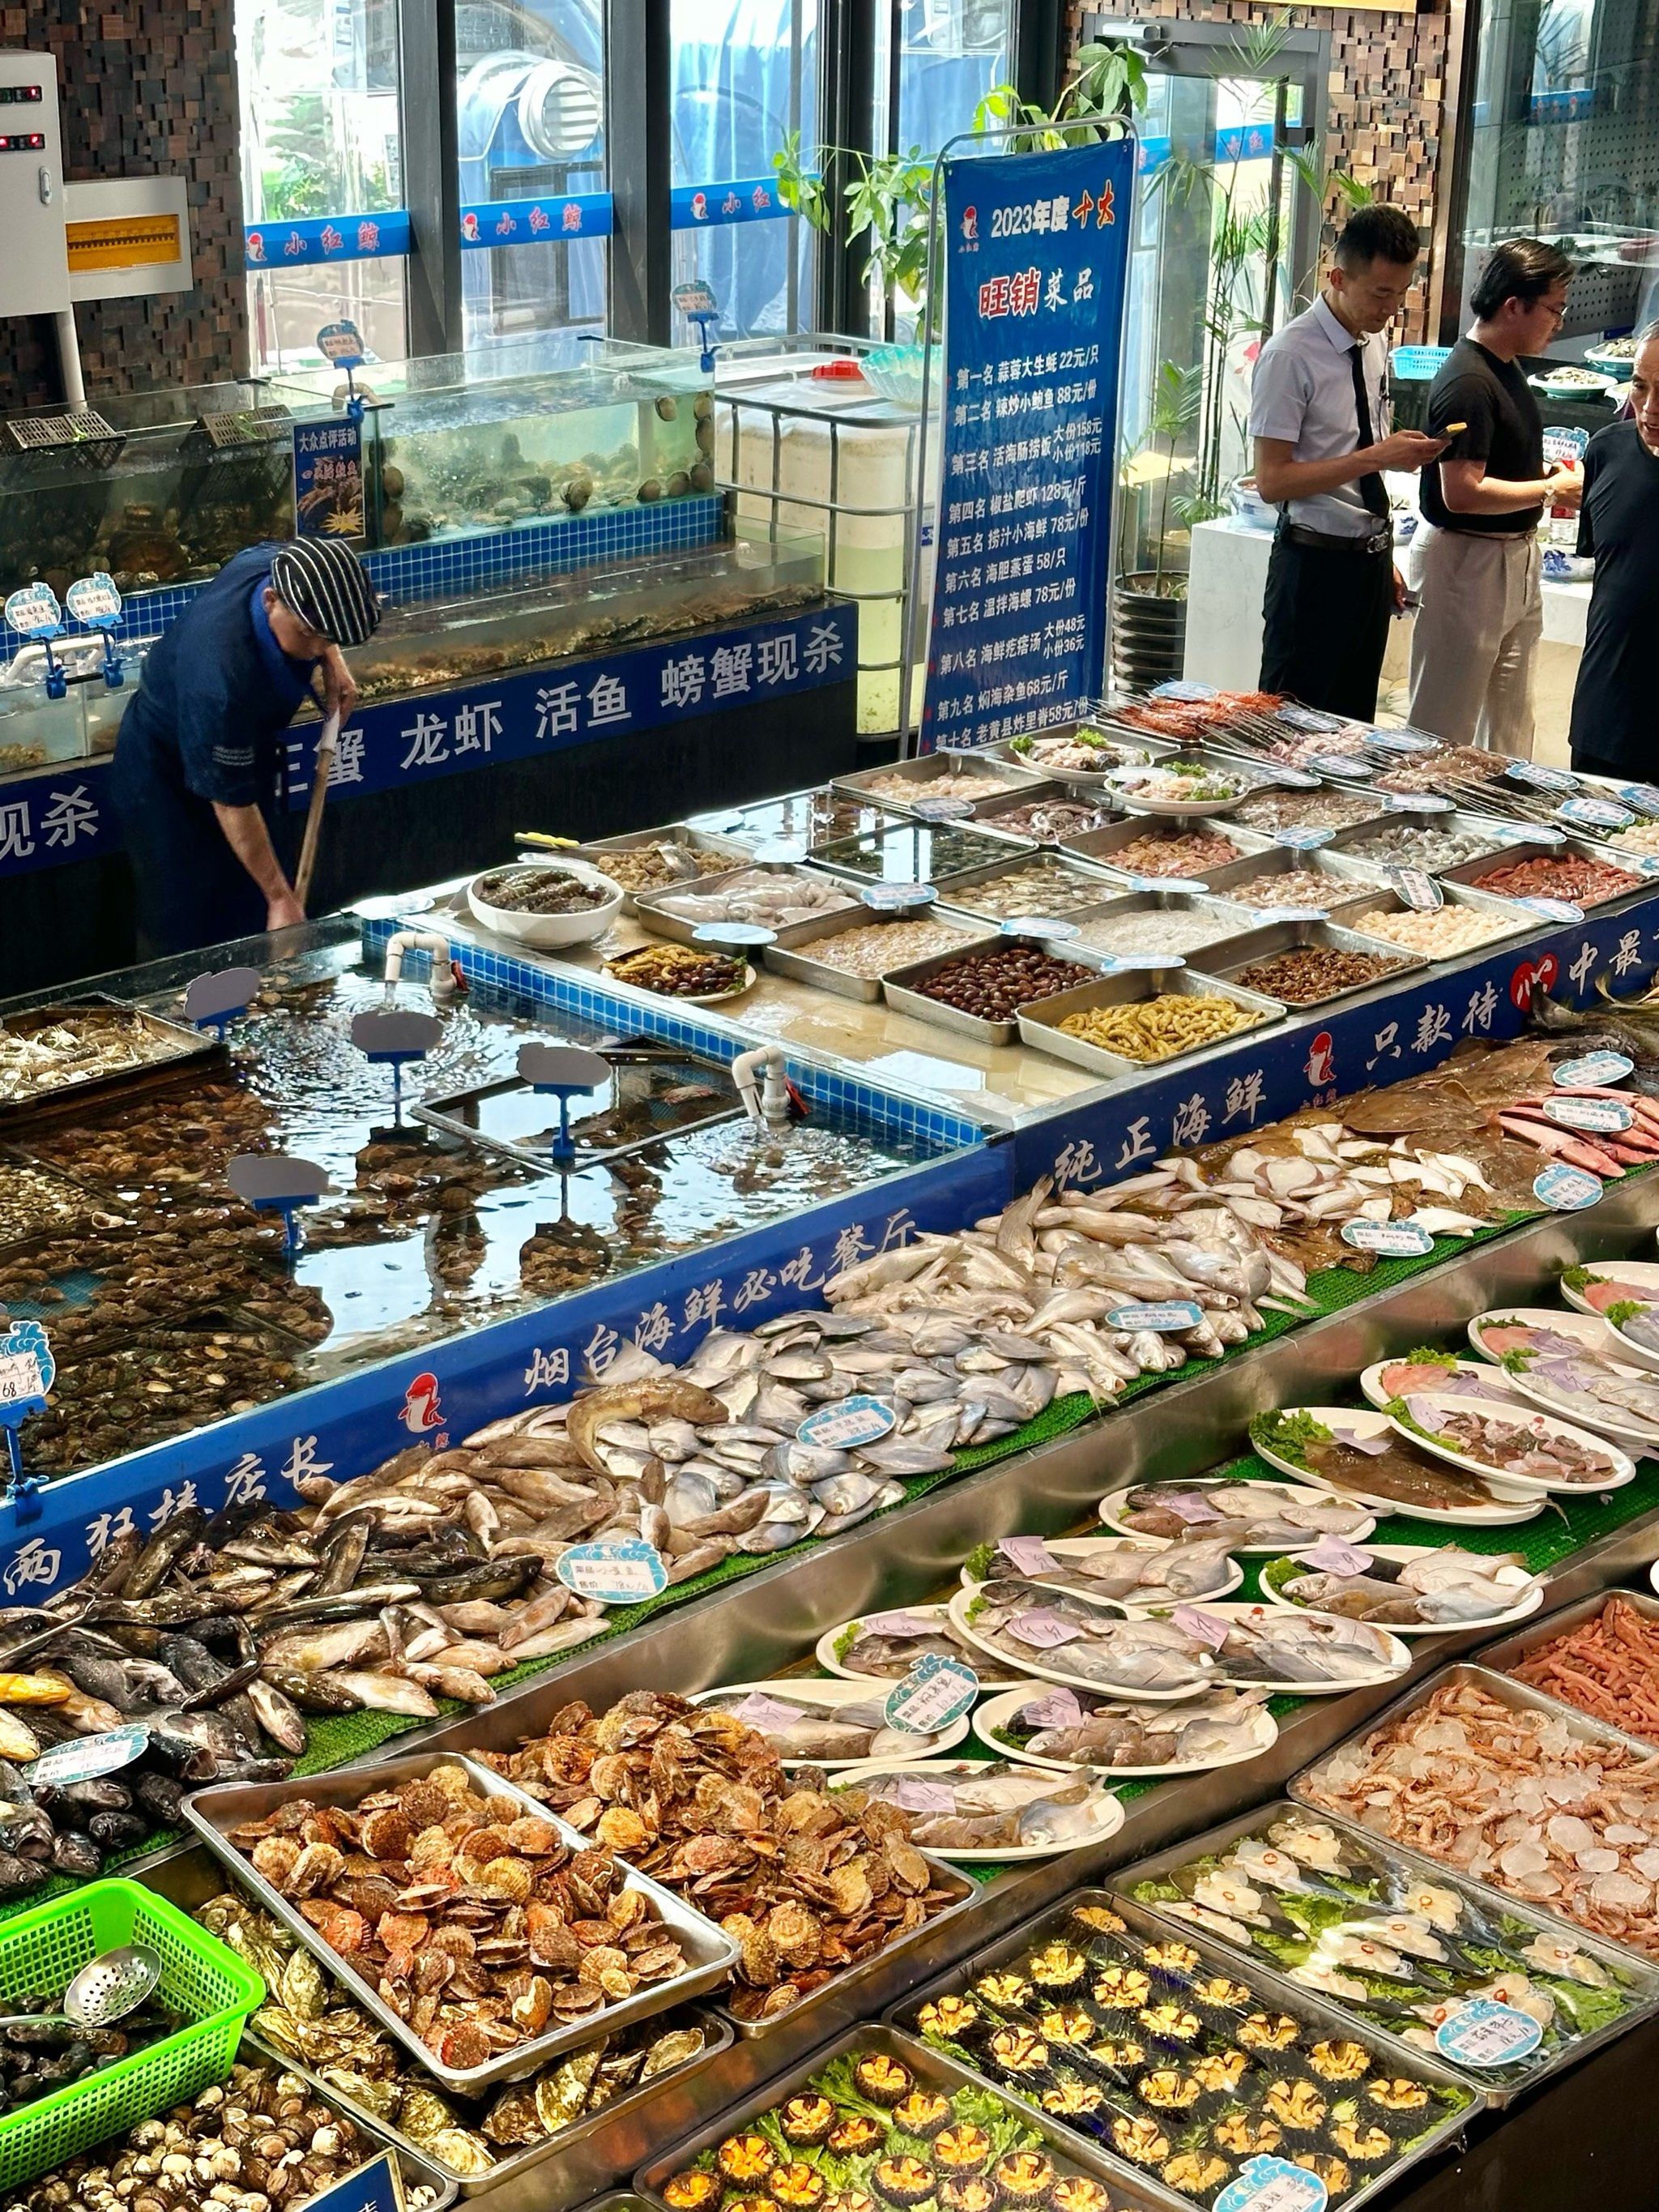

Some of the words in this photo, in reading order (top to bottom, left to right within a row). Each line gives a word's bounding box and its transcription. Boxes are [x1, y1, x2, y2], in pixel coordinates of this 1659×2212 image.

[284, 221, 380, 255] 小红鲸
[979, 267, 1093, 320] 旺销菜品
[957, 364, 993, 391] 第一名
[997, 352, 1057, 383] 蒜蓉大生蚝
[1060, 344, 1099, 369] 22元/只
[953, 399, 992, 426] 第二名
[996, 388, 1054, 418] 辣炒小鲍鱼
[1057, 378, 1098, 404] 88元/份
[299, 427, 356, 453] 大众点评活动
[951, 449, 989, 476] 第三名
[992, 436, 1052, 468] 活海肠捞饭
[948, 497, 985, 524] 第四名
[990, 487, 1038, 515] 椒盐爬虾
[1040, 475, 1087, 501] 128元/斤
[946, 532, 983, 559] 第五名
[987, 517, 1047, 550] 捞汁小海鲜
[1051, 507, 1089, 535] 78元/份
[945, 567, 981, 594] 第六名
[986, 553, 1034, 585] 海胆蒸蛋
[1036, 547, 1067, 571] 58/只
[942, 602, 979, 629] 第七名
[983, 588, 1032, 617] 温拌海螺
[1034, 578, 1076, 604] 78元/份
[1043, 614, 1085, 640] 大份48元
[940, 649, 977, 676] 第八名
[981, 633, 1041, 664] 海鲜疙瘩汤
[1043, 634, 1085, 660] 小份36元
[400, 700, 504, 771] 龙虾
[535, 673, 633, 740] 活鱼
[660, 620, 844, 709] 螃蟹现杀
[936, 694, 973, 721] 第九名
[1055, 1069, 1266, 1193] 纯正海鲜
